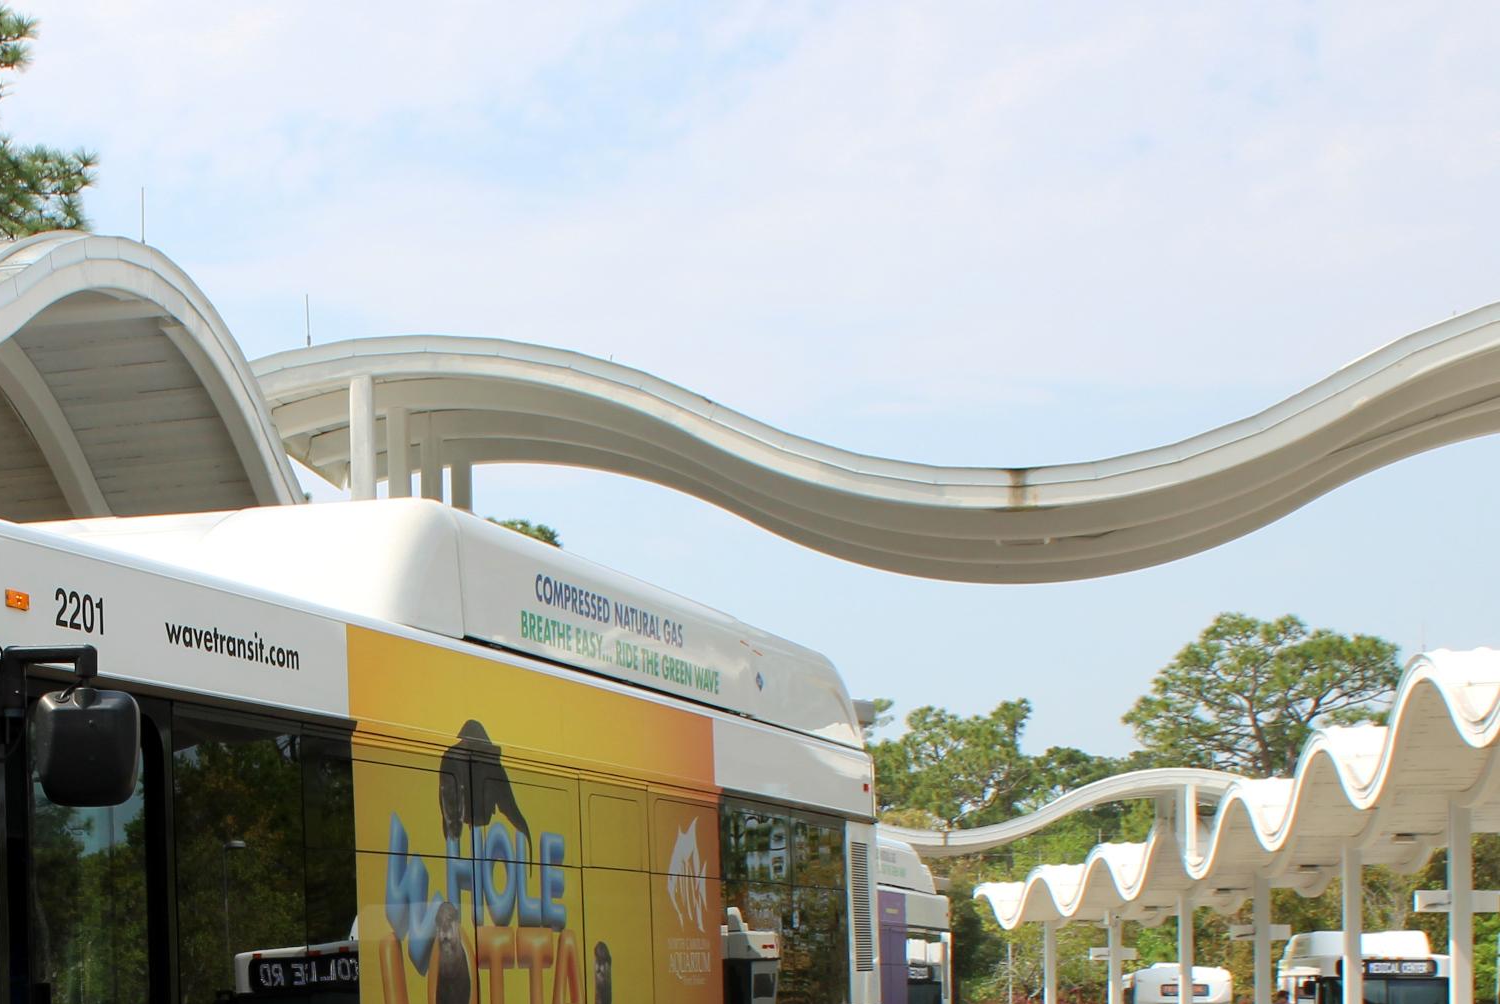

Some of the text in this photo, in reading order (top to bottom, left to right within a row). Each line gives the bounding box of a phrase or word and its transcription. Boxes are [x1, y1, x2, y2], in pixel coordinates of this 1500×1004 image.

[55, 588, 104, 635] 2201
[165, 622, 300, 670] wavetransit.com
[535, 574, 683, 648] COMPRESSED NATURAL GAS
[521, 610, 572, 652] BREATHE
[615, 639, 638, 671] RIDE
[640, 647, 659, 677] THE
[662, 654, 692, 688] GREEN
[694, 664, 720, 694] WAVE
[384, 811, 567, 976] WHOLE
